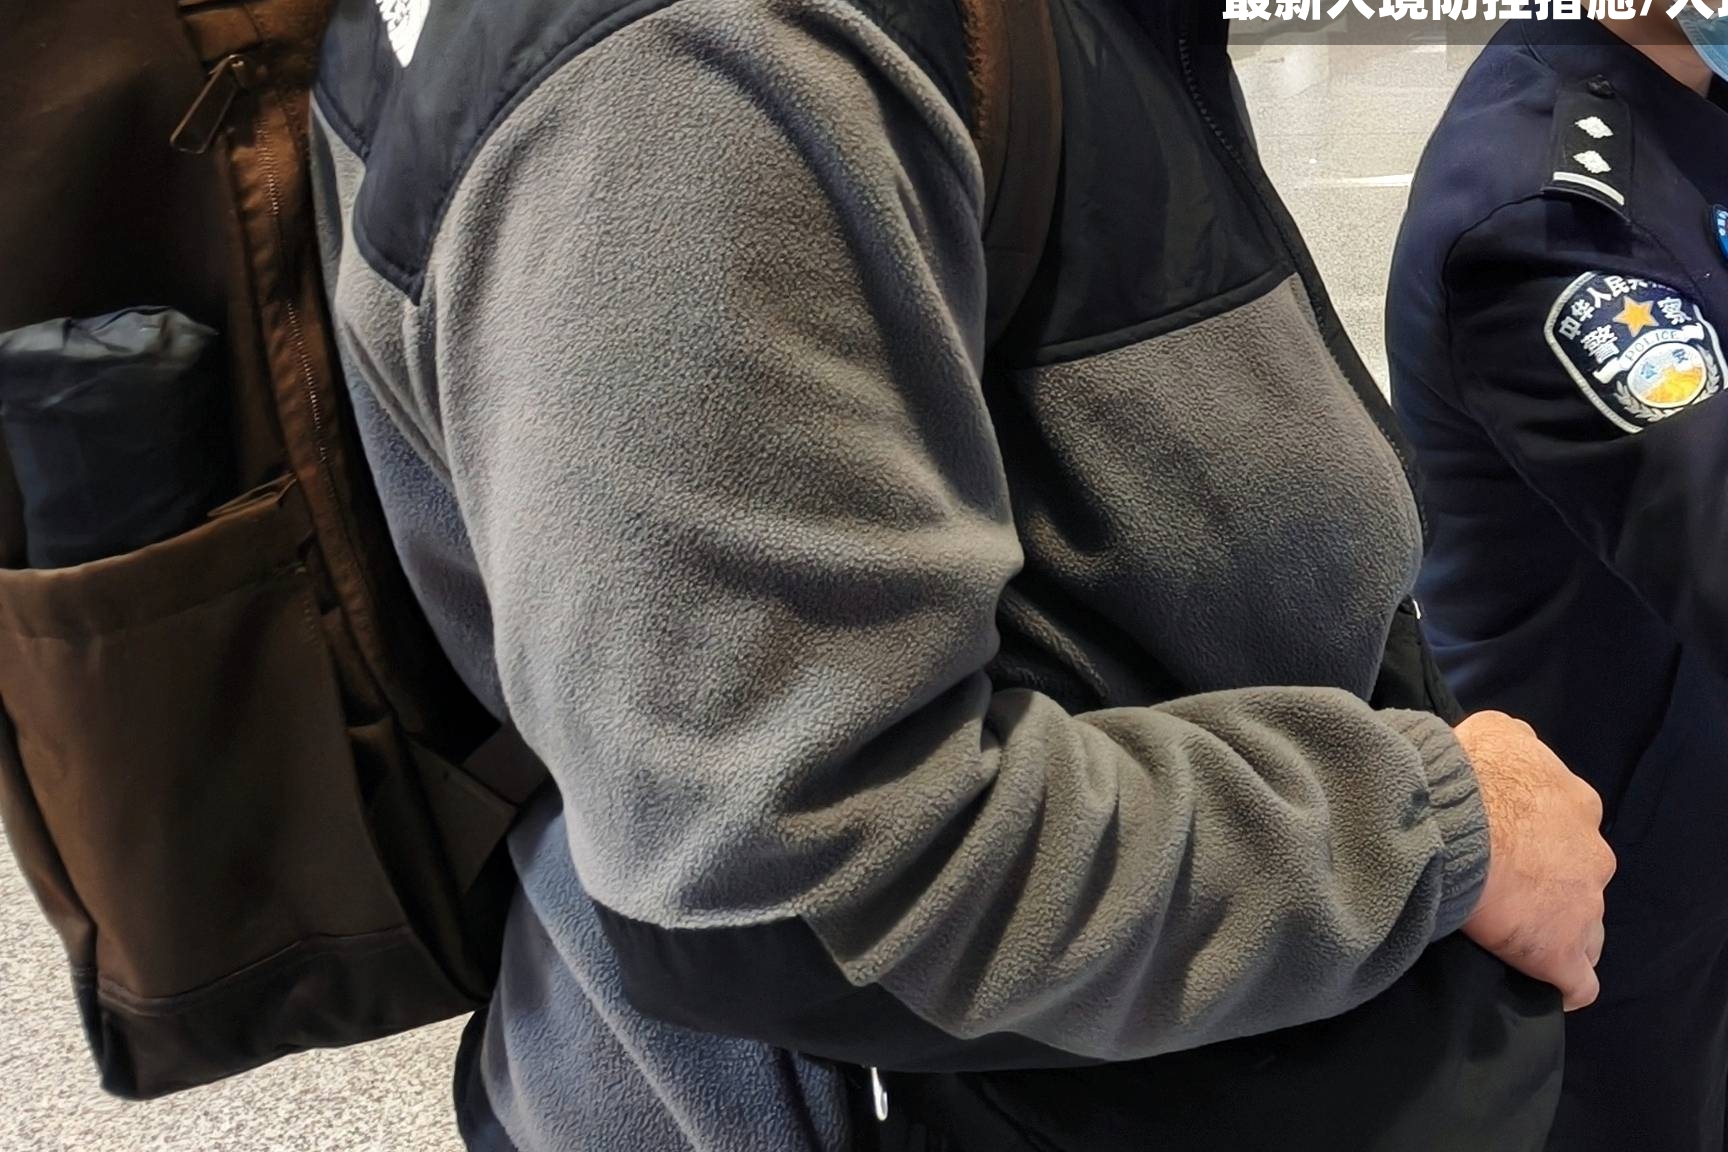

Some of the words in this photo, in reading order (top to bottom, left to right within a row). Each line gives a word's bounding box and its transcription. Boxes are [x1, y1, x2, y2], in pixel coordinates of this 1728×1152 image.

[1558, 275, 1680, 340] 中华人民
[1624, 330, 1678, 361] POLICE
